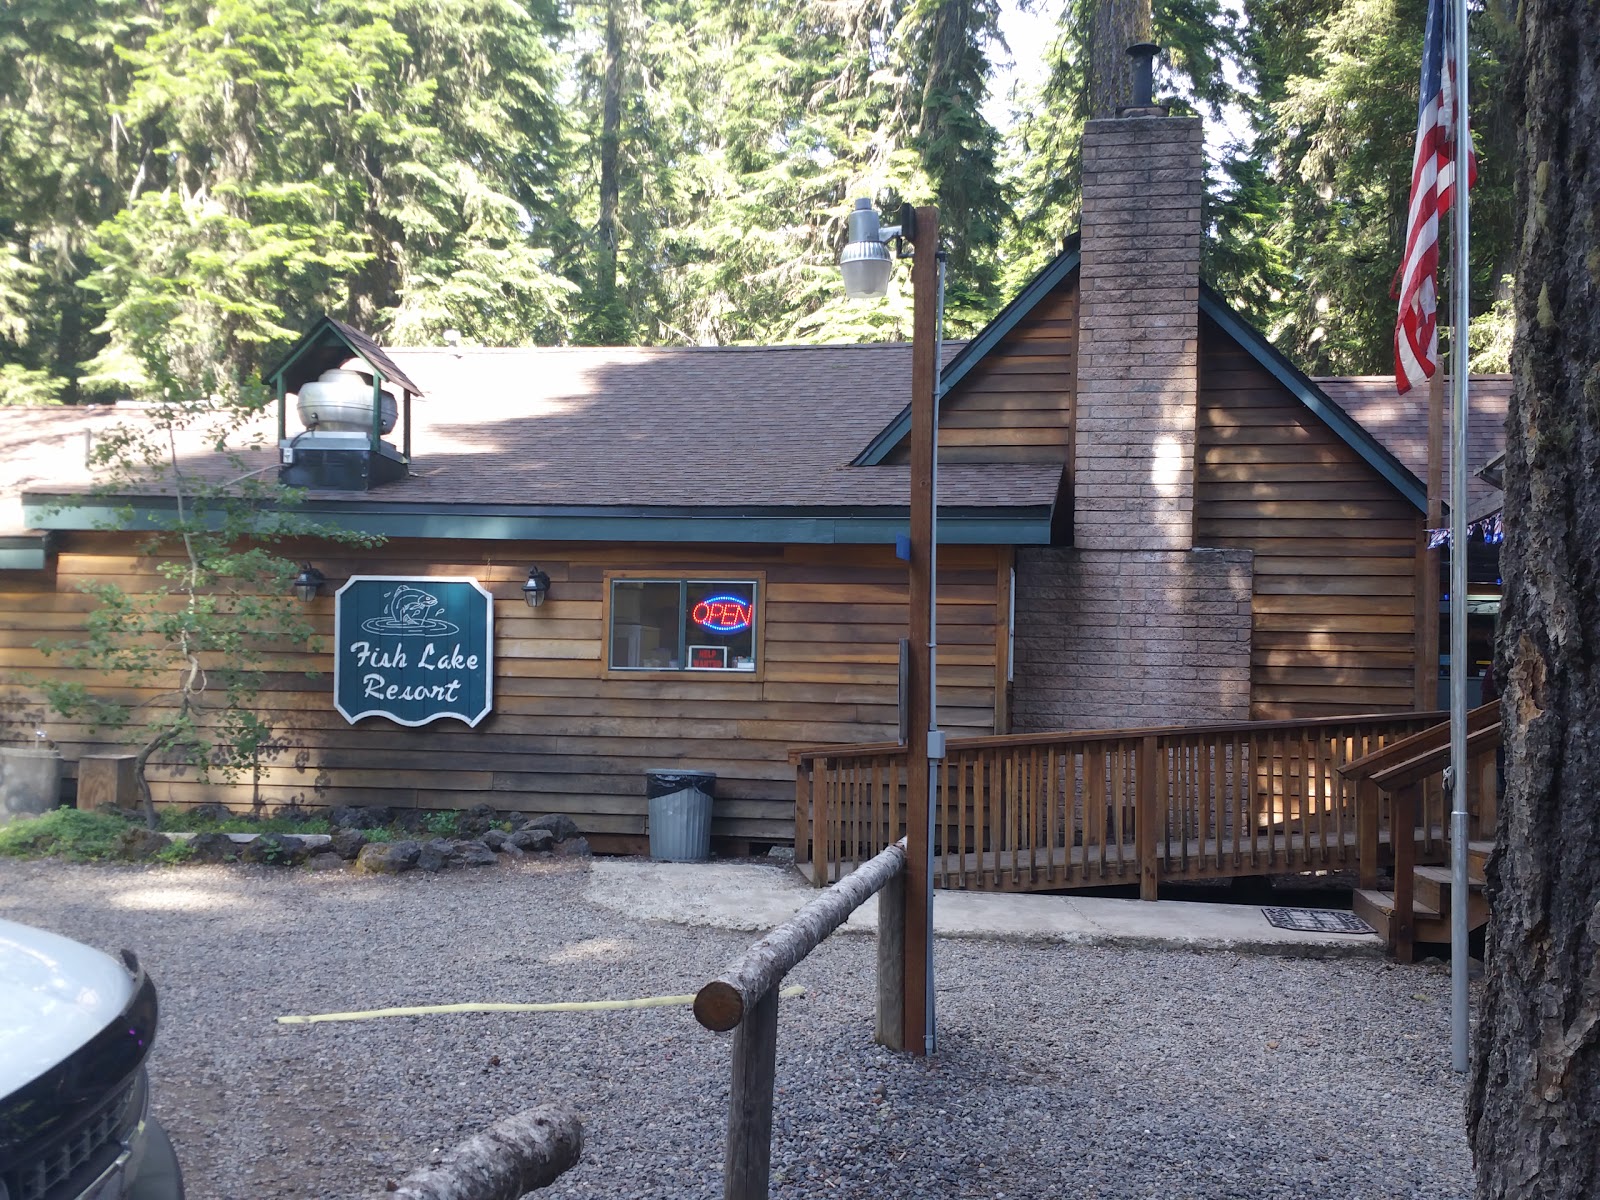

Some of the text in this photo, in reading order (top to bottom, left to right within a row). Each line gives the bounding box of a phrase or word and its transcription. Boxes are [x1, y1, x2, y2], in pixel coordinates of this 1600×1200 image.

[693, 602, 753, 626] OPEN
[350, 641, 478, 670] Fish Lake
[699, 649, 717, 658] HELP
[363, 673, 461, 702] Resort
